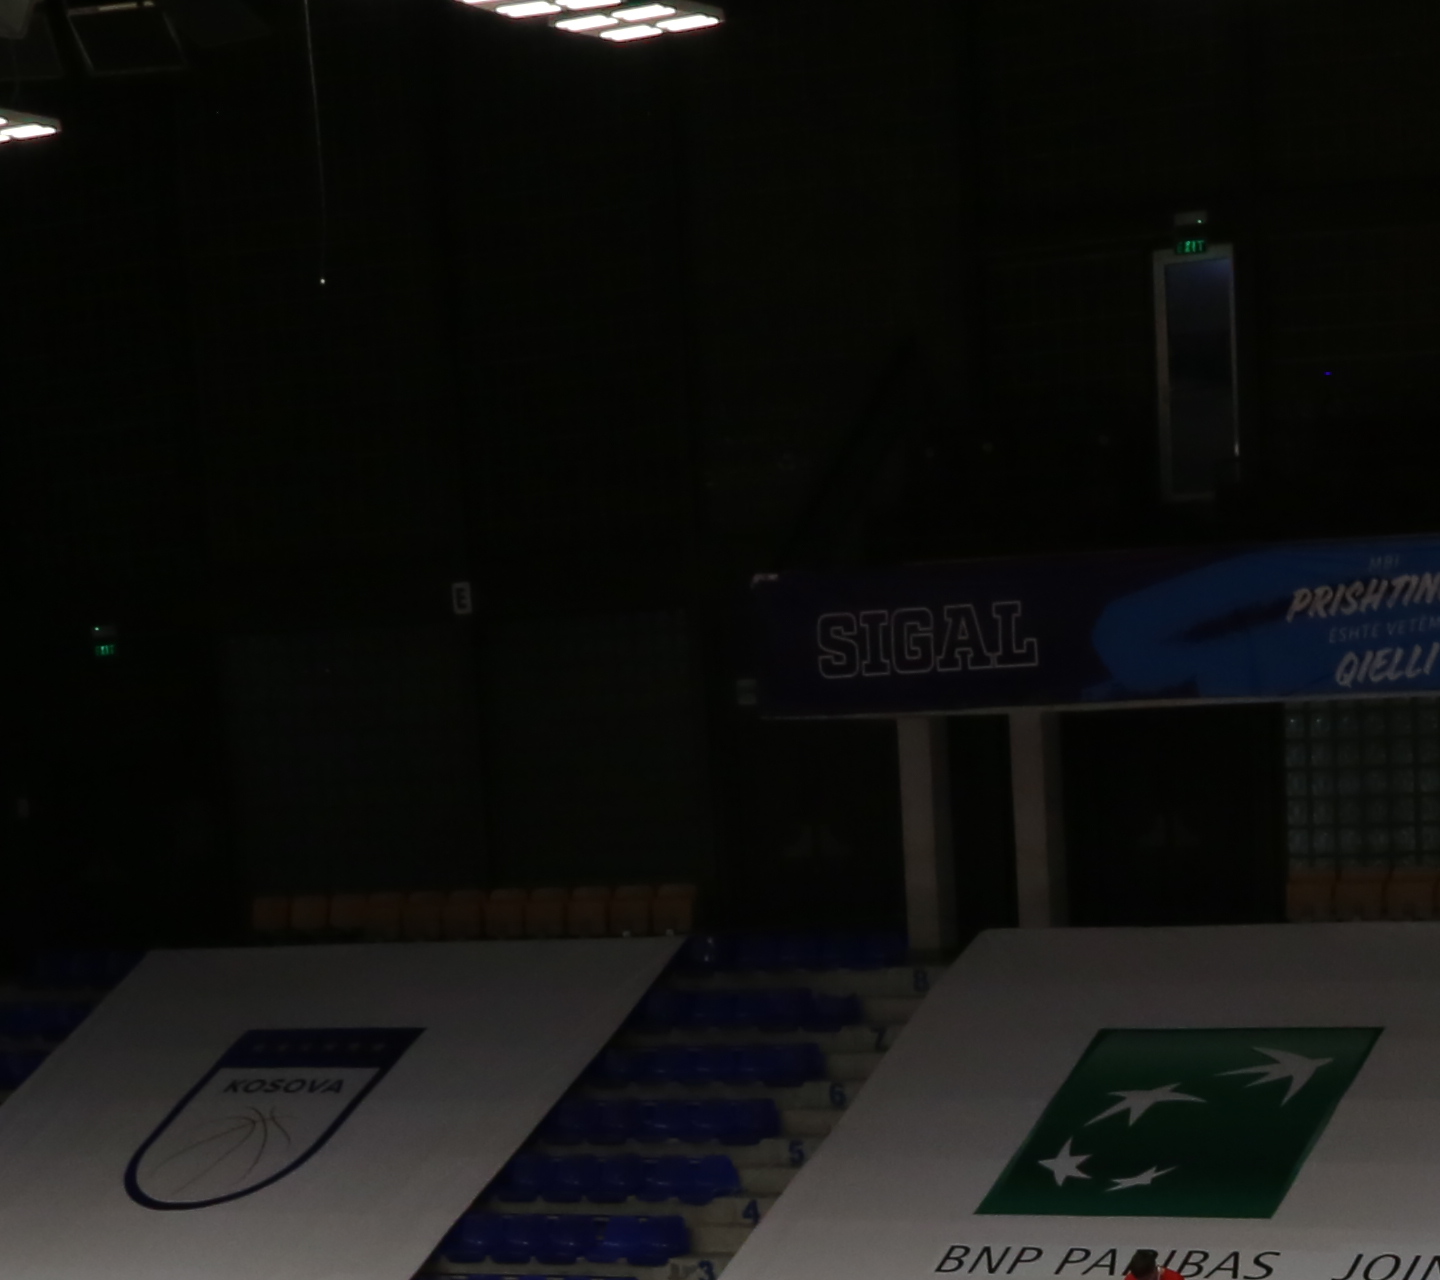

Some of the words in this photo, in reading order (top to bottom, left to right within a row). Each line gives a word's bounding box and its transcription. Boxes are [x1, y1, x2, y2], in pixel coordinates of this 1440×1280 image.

[816, 599, 1039, 680] SIGAL
[222, 1078, 344, 1094] KOSOVA
[829, 1083, 847, 1107] 6
[789, 1140, 806, 1166] 5
[935, 1244, 1044, 1275] BNP
